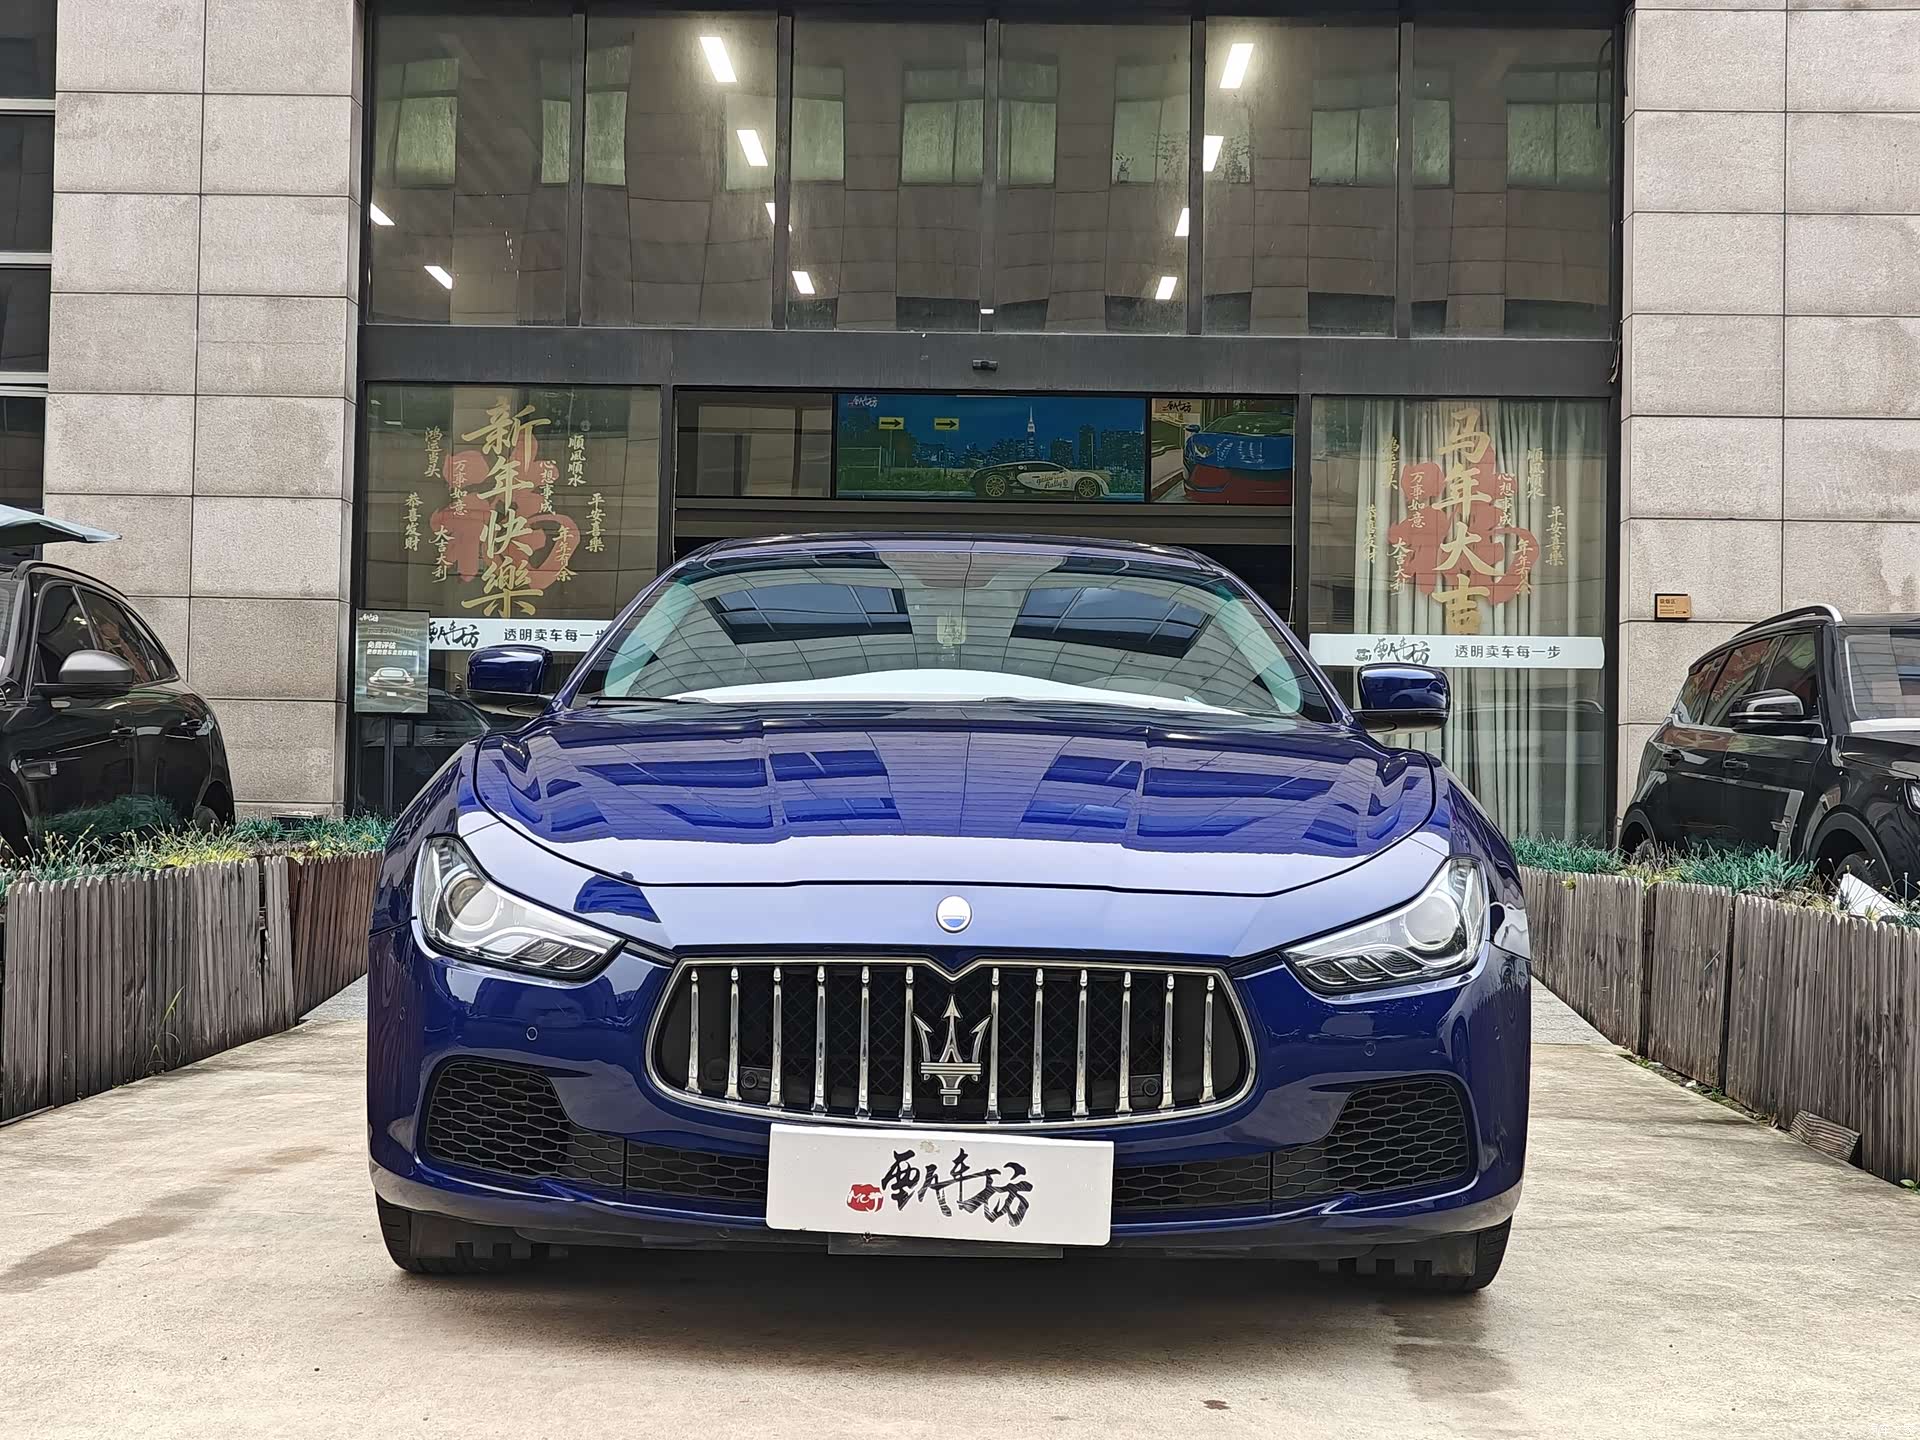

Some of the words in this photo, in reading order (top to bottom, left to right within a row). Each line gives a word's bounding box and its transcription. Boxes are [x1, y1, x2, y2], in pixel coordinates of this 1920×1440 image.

[424, 426, 443, 479] 鸿运当头
[450, 460, 469, 516] 万事如意
[461, 397, 551, 618] 新年快樂
[539, 459, 556, 516] 心想事成
[1407, 471, 1427, 529] 万事如意
[1494, 472, 1516, 527] 心想事成
[402, 492, 424, 552] 恭喜发财
[1432, 407, 1506, 634] 马年大吉
[428, 526, 455, 583] 大吉大利
[552, 526, 578, 583] 年年有余
[1386, 537, 1414, 596] 大吉大利
[1454, 644, 1562, 660] 透明卖车每一步
